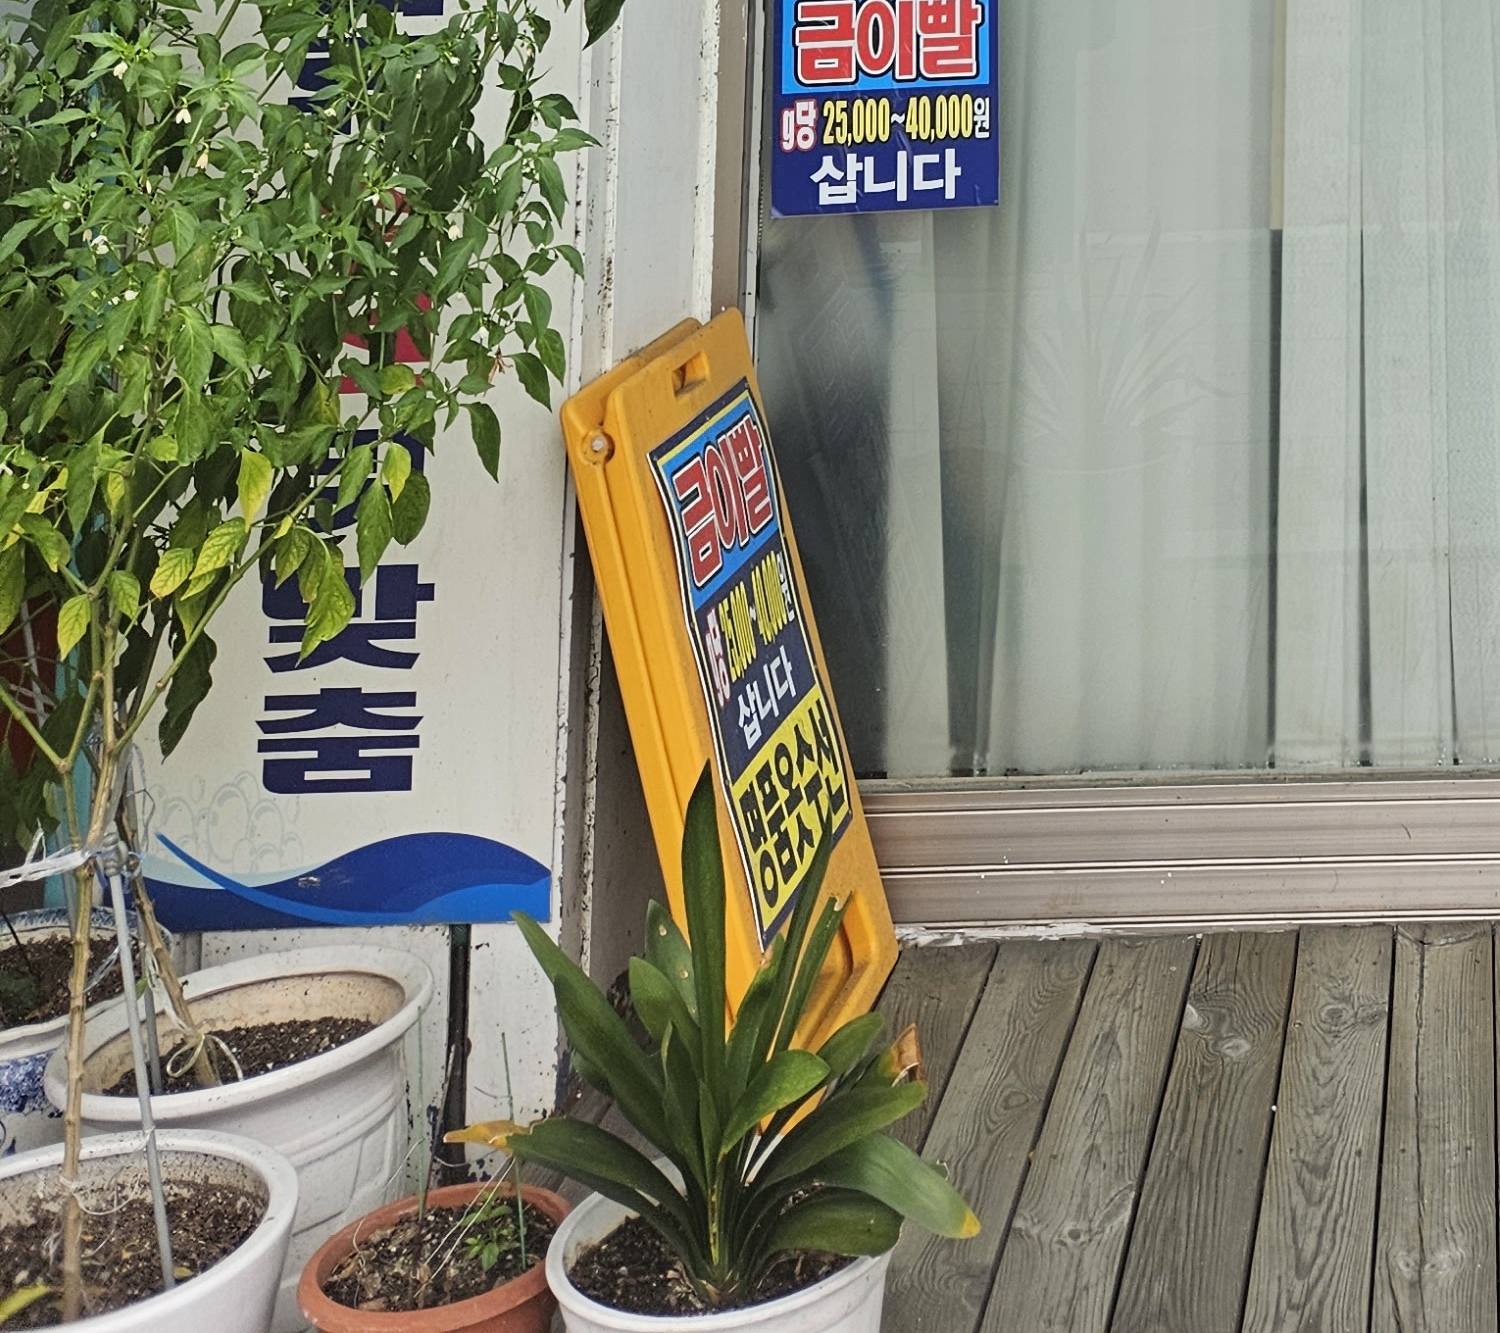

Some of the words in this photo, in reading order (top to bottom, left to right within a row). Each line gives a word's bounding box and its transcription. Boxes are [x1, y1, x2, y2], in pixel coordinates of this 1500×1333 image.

[781, 99, 818, 152] g당
[810, 148, 961, 206] 삽니다
[673, 414, 774, 588] 금이빨
[738, 645, 797, 750] 삽니다
